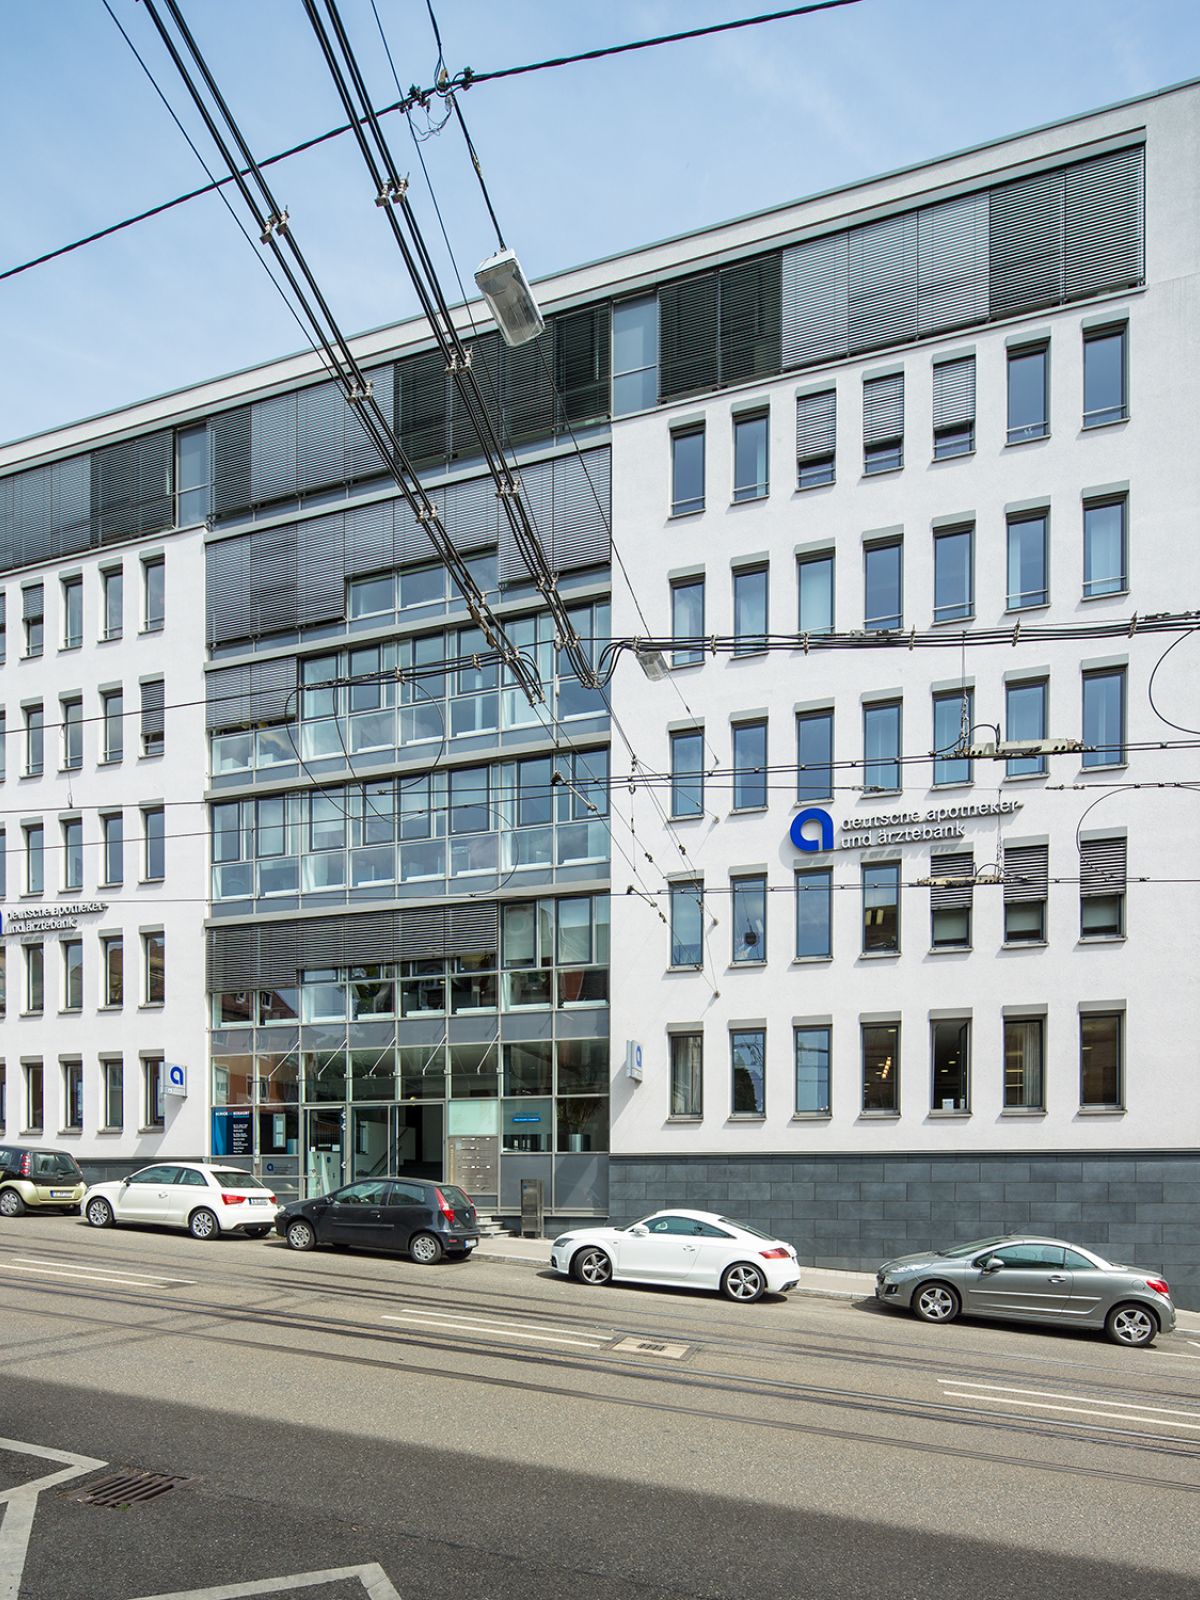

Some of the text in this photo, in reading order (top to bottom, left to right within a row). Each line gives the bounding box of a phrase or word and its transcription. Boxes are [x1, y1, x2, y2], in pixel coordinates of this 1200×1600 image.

[842, 808, 924, 830] deutsche
[842, 821, 966, 848] und ärztebank
